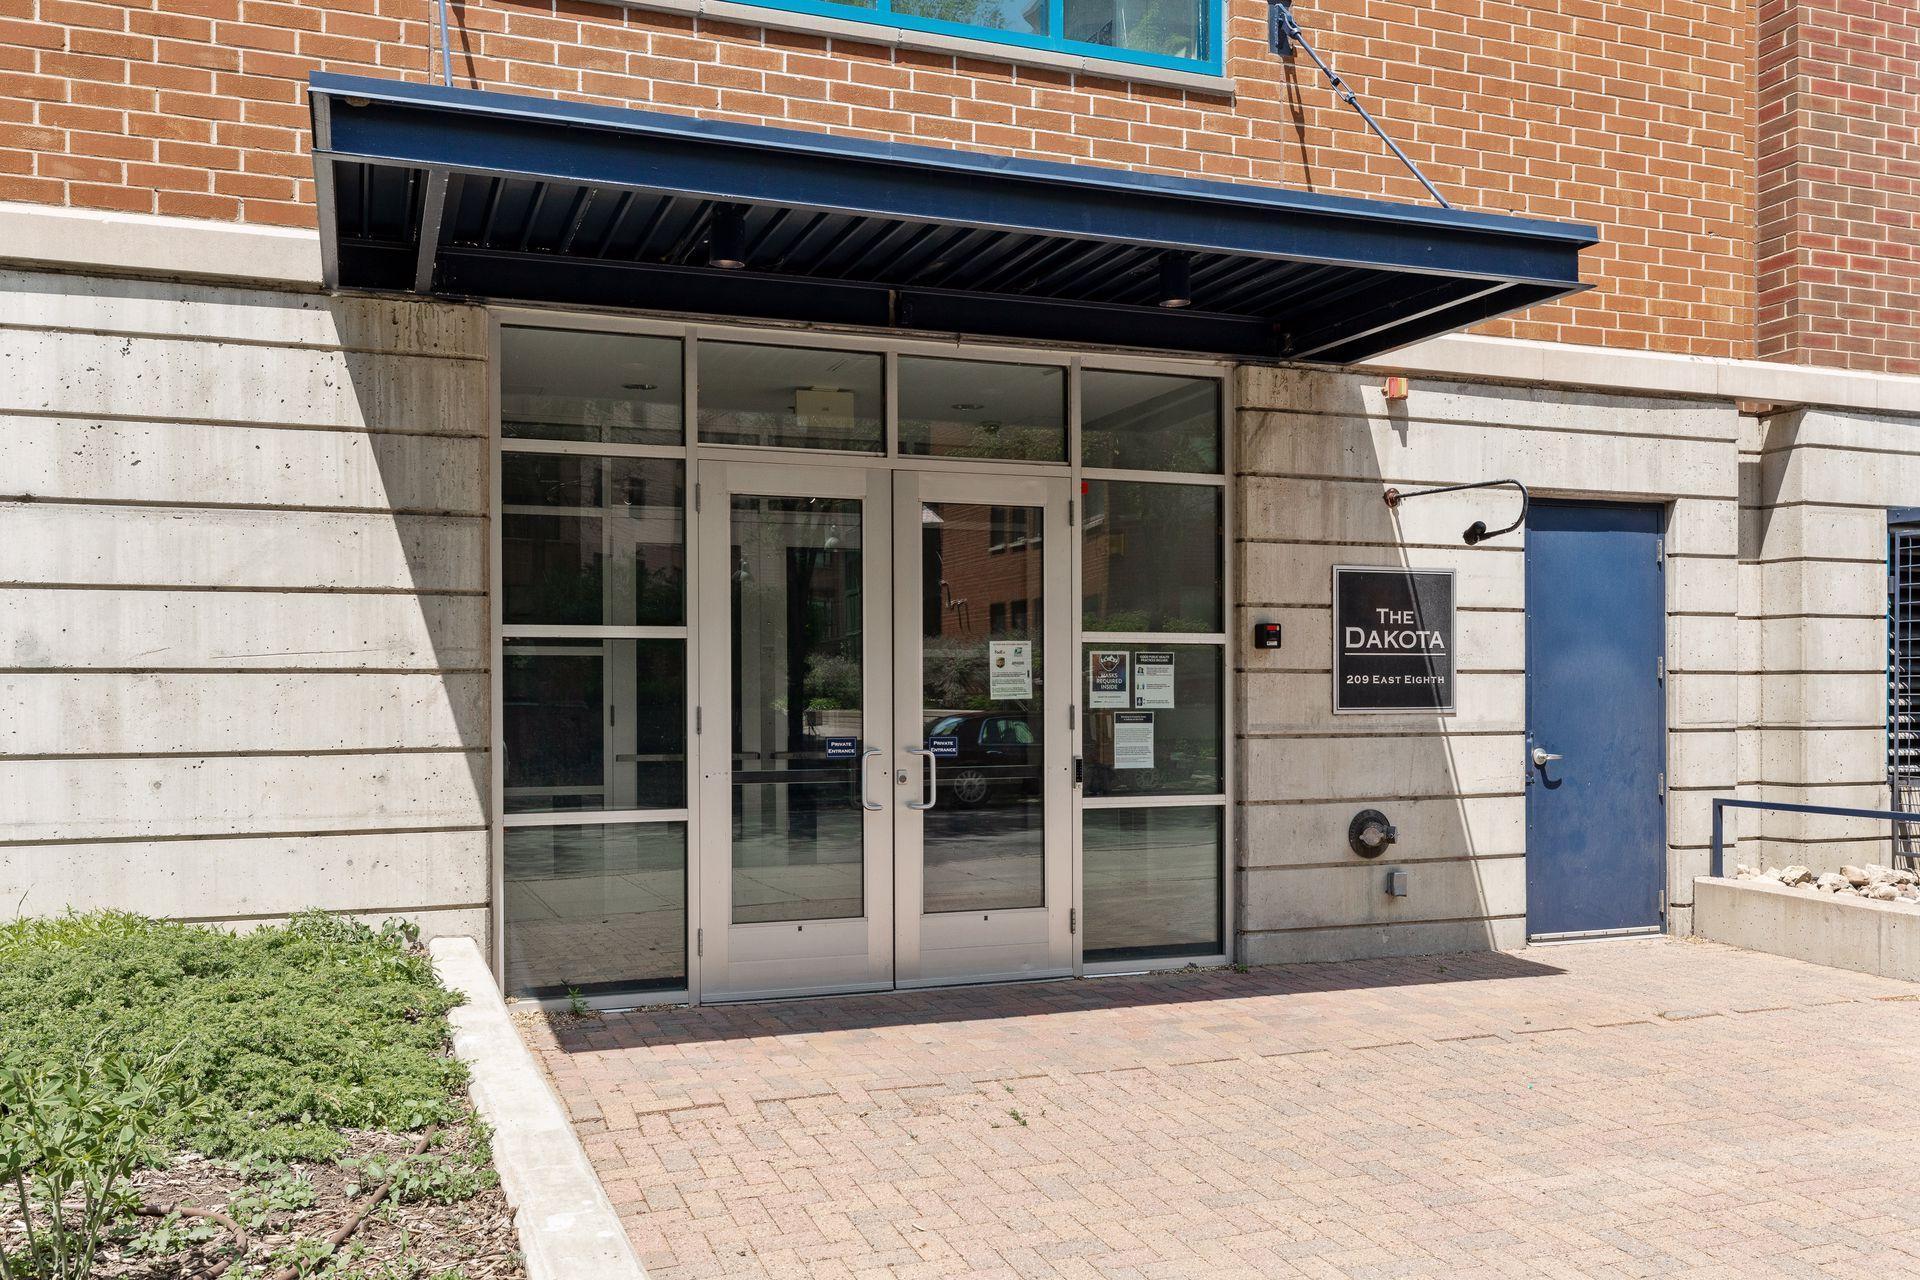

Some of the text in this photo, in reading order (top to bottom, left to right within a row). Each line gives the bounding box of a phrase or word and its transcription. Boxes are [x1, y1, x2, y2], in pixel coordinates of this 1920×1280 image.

[1376, 608, 1414, 624] THE
[1345, 626, 1445, 649] DAKOTA
[1346, 675, 1445, 684] 209 EAST EIGHTH
